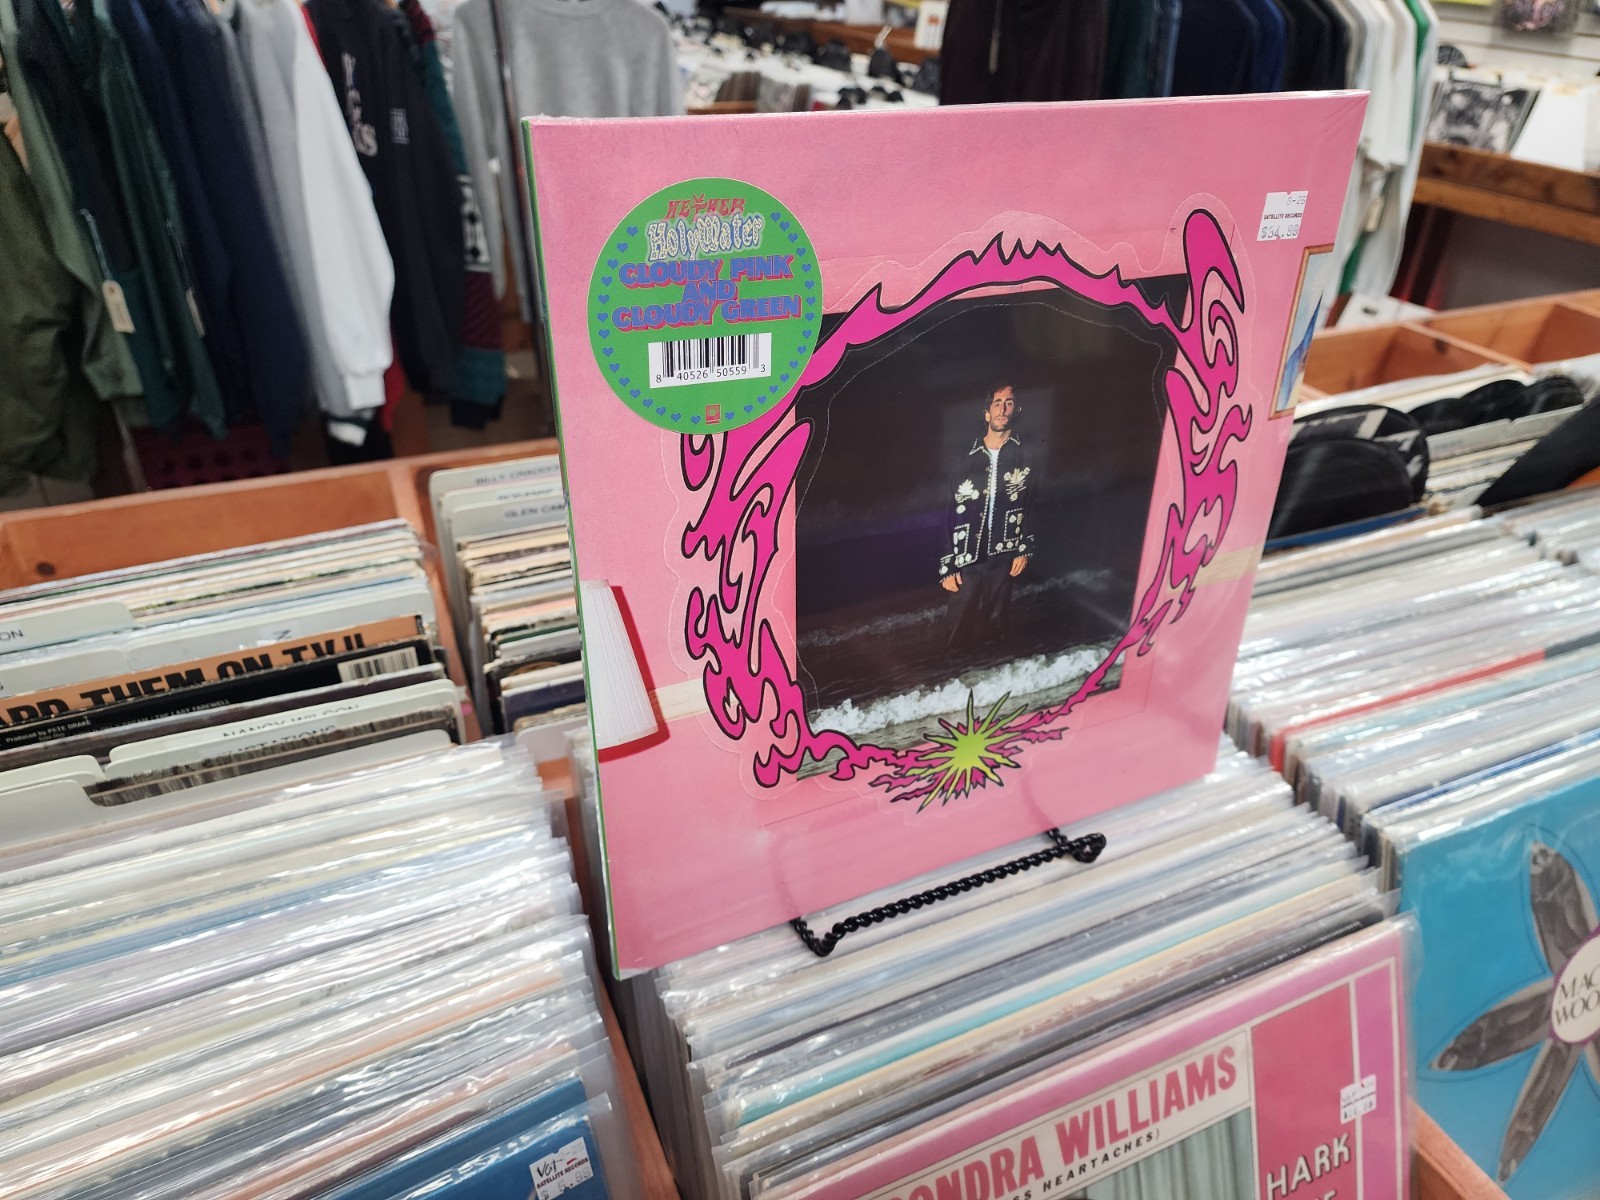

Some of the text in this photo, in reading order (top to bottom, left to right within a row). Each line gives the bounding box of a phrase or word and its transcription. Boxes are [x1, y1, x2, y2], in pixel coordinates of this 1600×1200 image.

[618, 254, 795, 290] CLOUDY PINK
[681, 279, 739, 304] AND
[611, 294, 802, 333] CLOUDY GREEN
[655, 363, 767, 383] 8 40526 50559 3
[1055, 1045, 1237, 1166] WILLIAMS
[536, 1157, 589, 1190] SATELLITE RECORDS
[1043, 1127, 1160, 1192] HEARTACHES)
[1266, 1132, 1351, 1200] HARK
